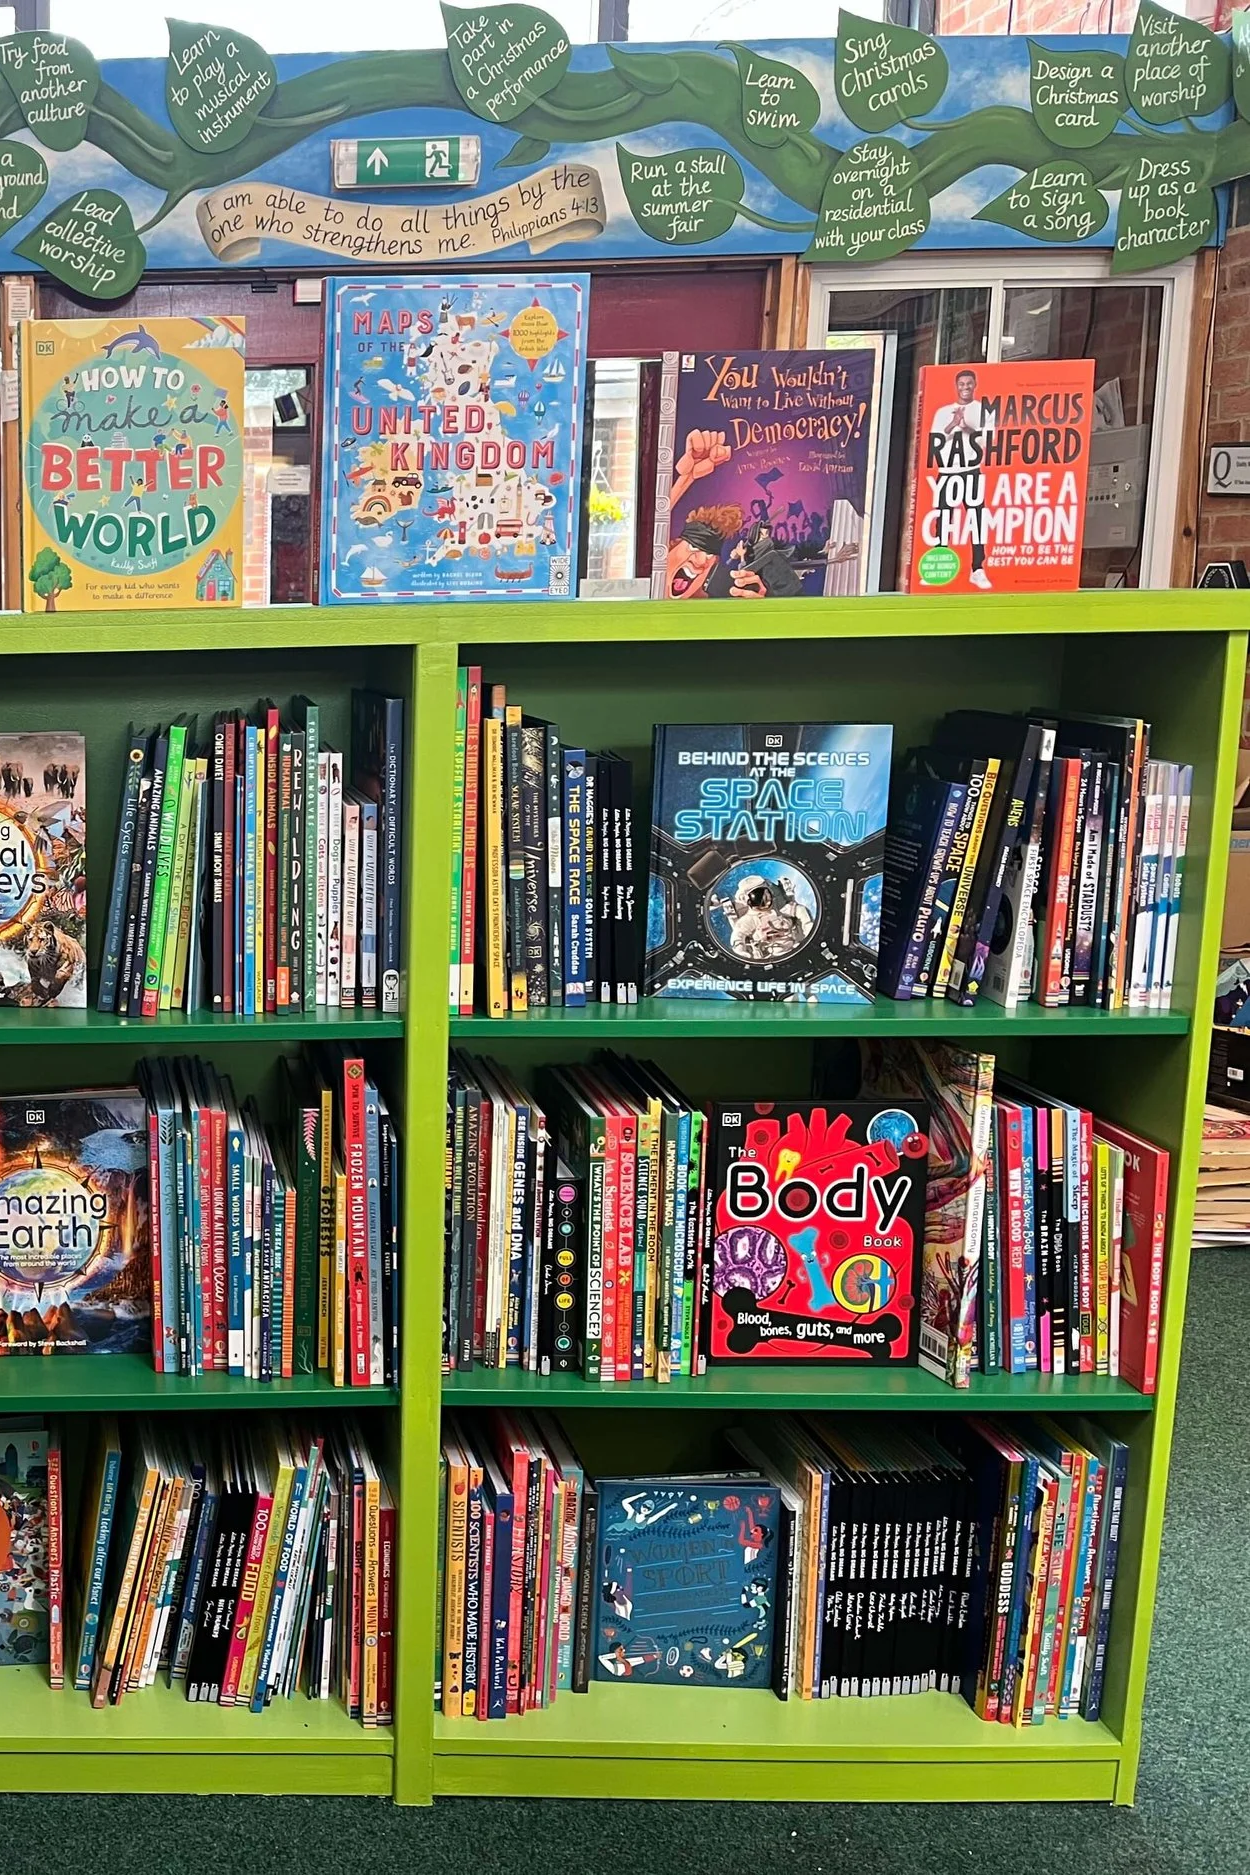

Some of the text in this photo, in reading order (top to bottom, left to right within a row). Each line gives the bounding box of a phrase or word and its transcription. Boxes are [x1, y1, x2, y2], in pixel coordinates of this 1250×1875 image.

[32, 37, 69, 58] food
[843, 32, 891, 63] Sing
[35, 60, 74, 83] from
[746, 63, 797, 89] Learn
[841, 41, 936, 97] Christmas
[1032, 60, 1114, 88] Design a
[20, 79, 87, 105] another
[759, 93, 780, 106] to
[867, 73, 928, 111] carols
[1036, 86, 1119, 105] Christmas
[28, 101, 86, 125] culture
[747, 109, 801, 128] swim
[1054, 106, 1100, 128] card
[203, 164, 591, 233] I am able to do all things by the
[211, 212, 476, 256] one who strengthens me.
[491, 209, 568, 243] Philippians
[353, 310, 434, 335] MAPS
[38, 343, 52, 352] DK
[358, 341, 404, 352] OF THE
[81, 366, 184, 392] HOW TO
[703, 355, 849, 400] You Wouldn't
[720, 390, 854, 411] Want to Live Without
[980, 393, 1084, 428] MARCUS
[50, 395, 209, 433] make a
[352, 405, 485, 435] UNITED
[730, 403, 867, 451] Democracy!
[390, 440, 555, 471] KINGDOM
[927, 428, 1082, 468] RASHFORD
[40, 442, 226, 493] BETTER
[926, 472, 1078, 508] YOU ARE A
[53, 504, 216, 558] WORLD
[921, 506, 1077, 546] CHAMPION
[986, 555, 1074, 567] BEST YOU CAN BE
[991, 545, 1074, 555] HOW TO BE THE
[101, 583, 121, 593] every
[768, 737, 780, 745] DK
[678, 752, 870, 765] BEHIND THE SCENES
[750, 768, 796, 777] AT THE
[700, 778, 844, 810] SPACE
[675, 811, 866, 842] STATION
[569, 786, 581, 905] THE SPACE RACE
[668, 979, 855, 994] EXPERIENCE LIFE IN SPACE
[29, 1112, 42, 1121] DK
[725, 1115, 739, 1124] DK
[729, 1147, 757, 1158] The
[350, 1144, 364, 1259] FROZEN MOUNTAIN
[618, 1152, 635, 1266] SCIENCE LAB
[726, 1162, 912, 1235] Body
[863, 1236, 902, 1247] Book
[737, 1312, 771, 1326] Blood,
[760, 1322, 852, 1339] bones, guts, and
[853, 1332, 885, 1343] more
[451, 1501, 465, 1562] SCIENTISTS
[997, 1562, 1013, 1614] GODDESS
